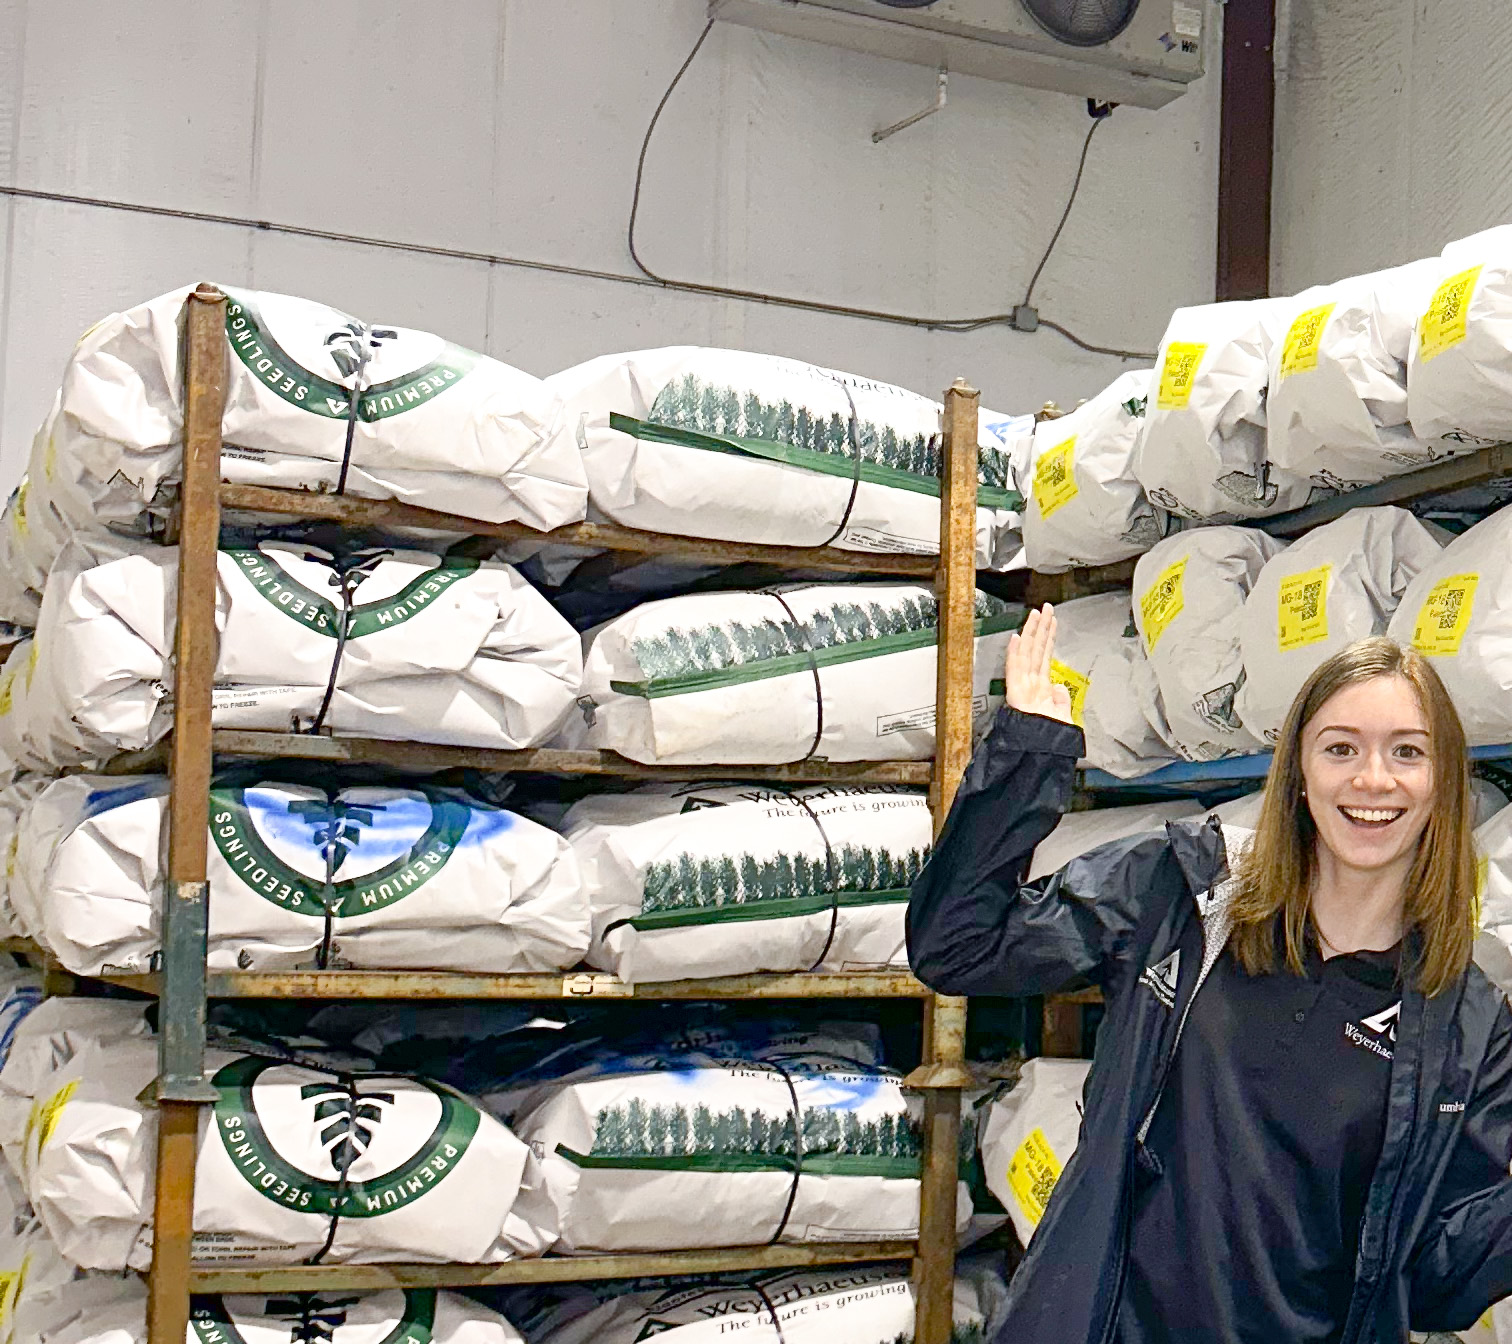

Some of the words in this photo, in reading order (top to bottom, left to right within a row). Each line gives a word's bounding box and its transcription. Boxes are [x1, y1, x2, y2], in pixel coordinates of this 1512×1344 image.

[227, 303, 309, 402] SEEDLINGS
[364, 369, 457, 416] PREMIUM
[762, 808, 795, 819] The
[852, 801, 866, 812] is
[214, 810, 306, 907] SEEDLINGS
[224, 1115, 313, 1208] SEEDLINGS
[366, 1143, 459, 1212] PREMIUM
[717, 1320, 751, 1334] The
[815, 1301, 831, 1312] is
[836, 1283, 907, 1307] growing
